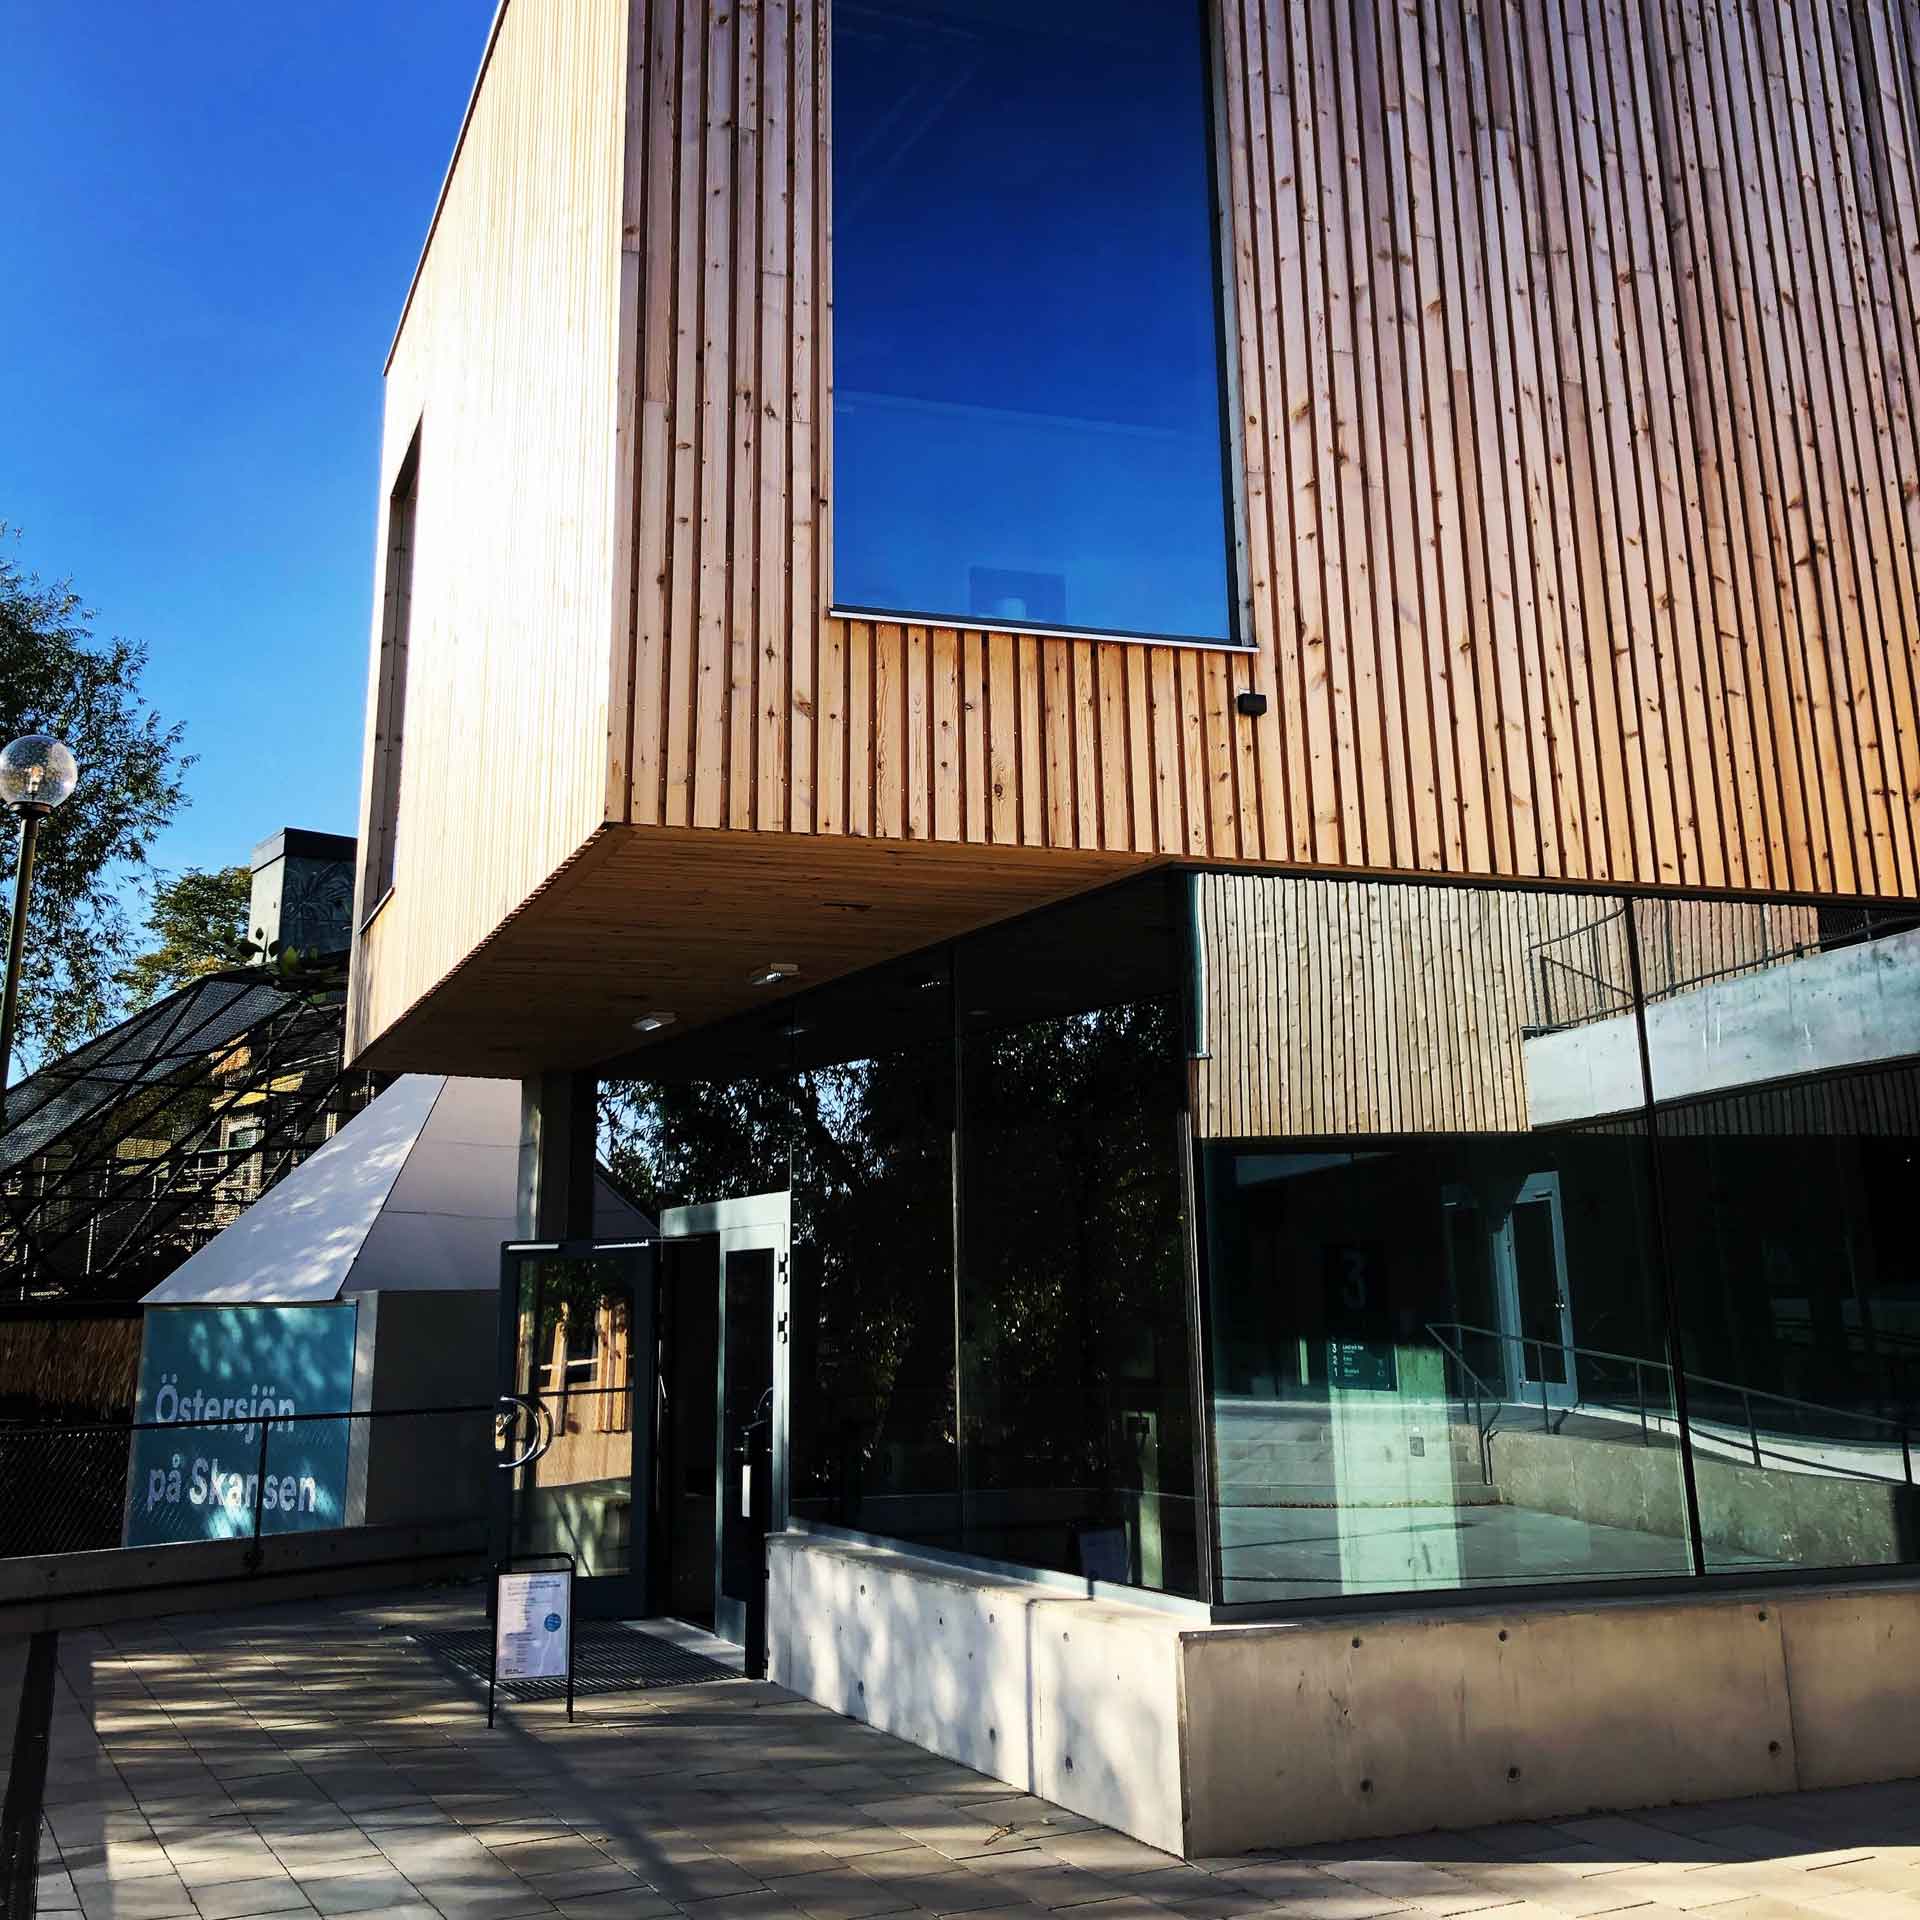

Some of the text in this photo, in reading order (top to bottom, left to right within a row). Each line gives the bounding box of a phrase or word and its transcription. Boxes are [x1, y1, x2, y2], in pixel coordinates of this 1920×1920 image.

[155, 1373, 296, 1444] Östersjön
[146, 1453, 316, 1512] på Skansen
